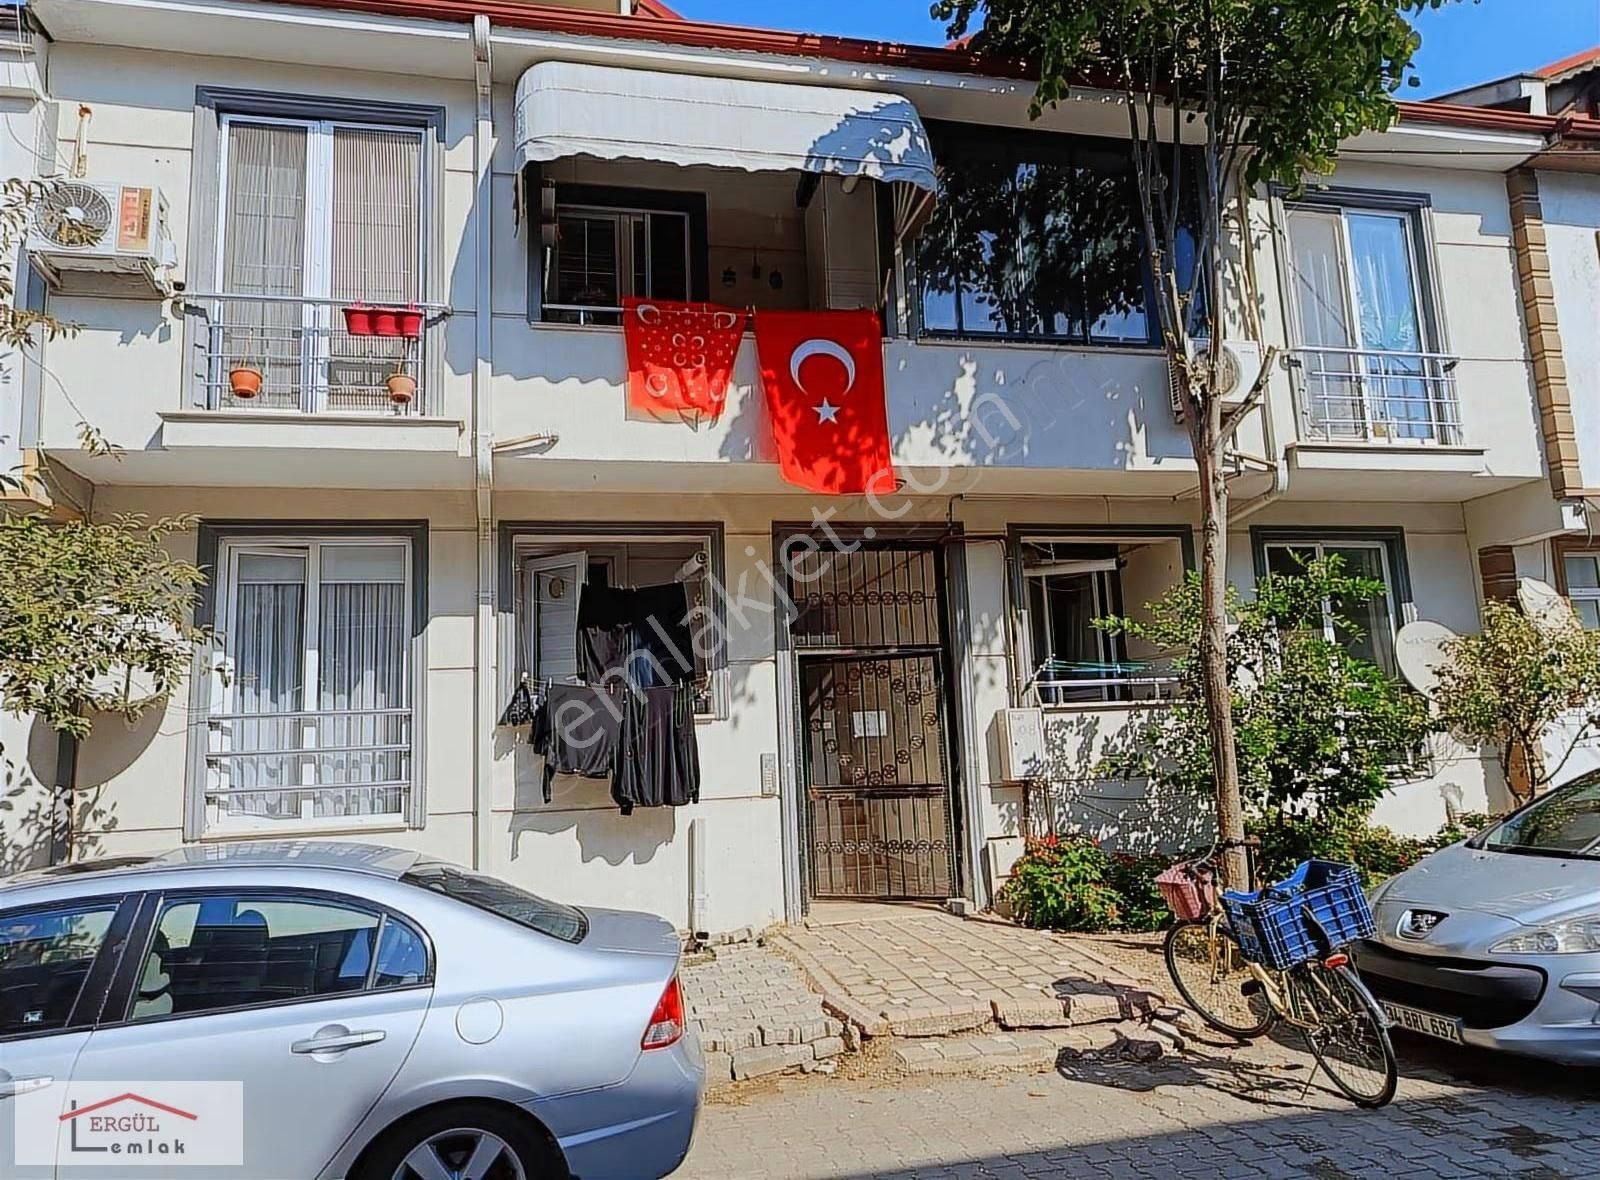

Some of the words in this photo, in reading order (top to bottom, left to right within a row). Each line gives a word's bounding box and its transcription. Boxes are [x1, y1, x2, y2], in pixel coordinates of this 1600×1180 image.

[1385, 1005, 1402, 1025] 34
[1403, 1010, 1430, 1033] BRL
[1430, 1018, 1458, 1041] 692
